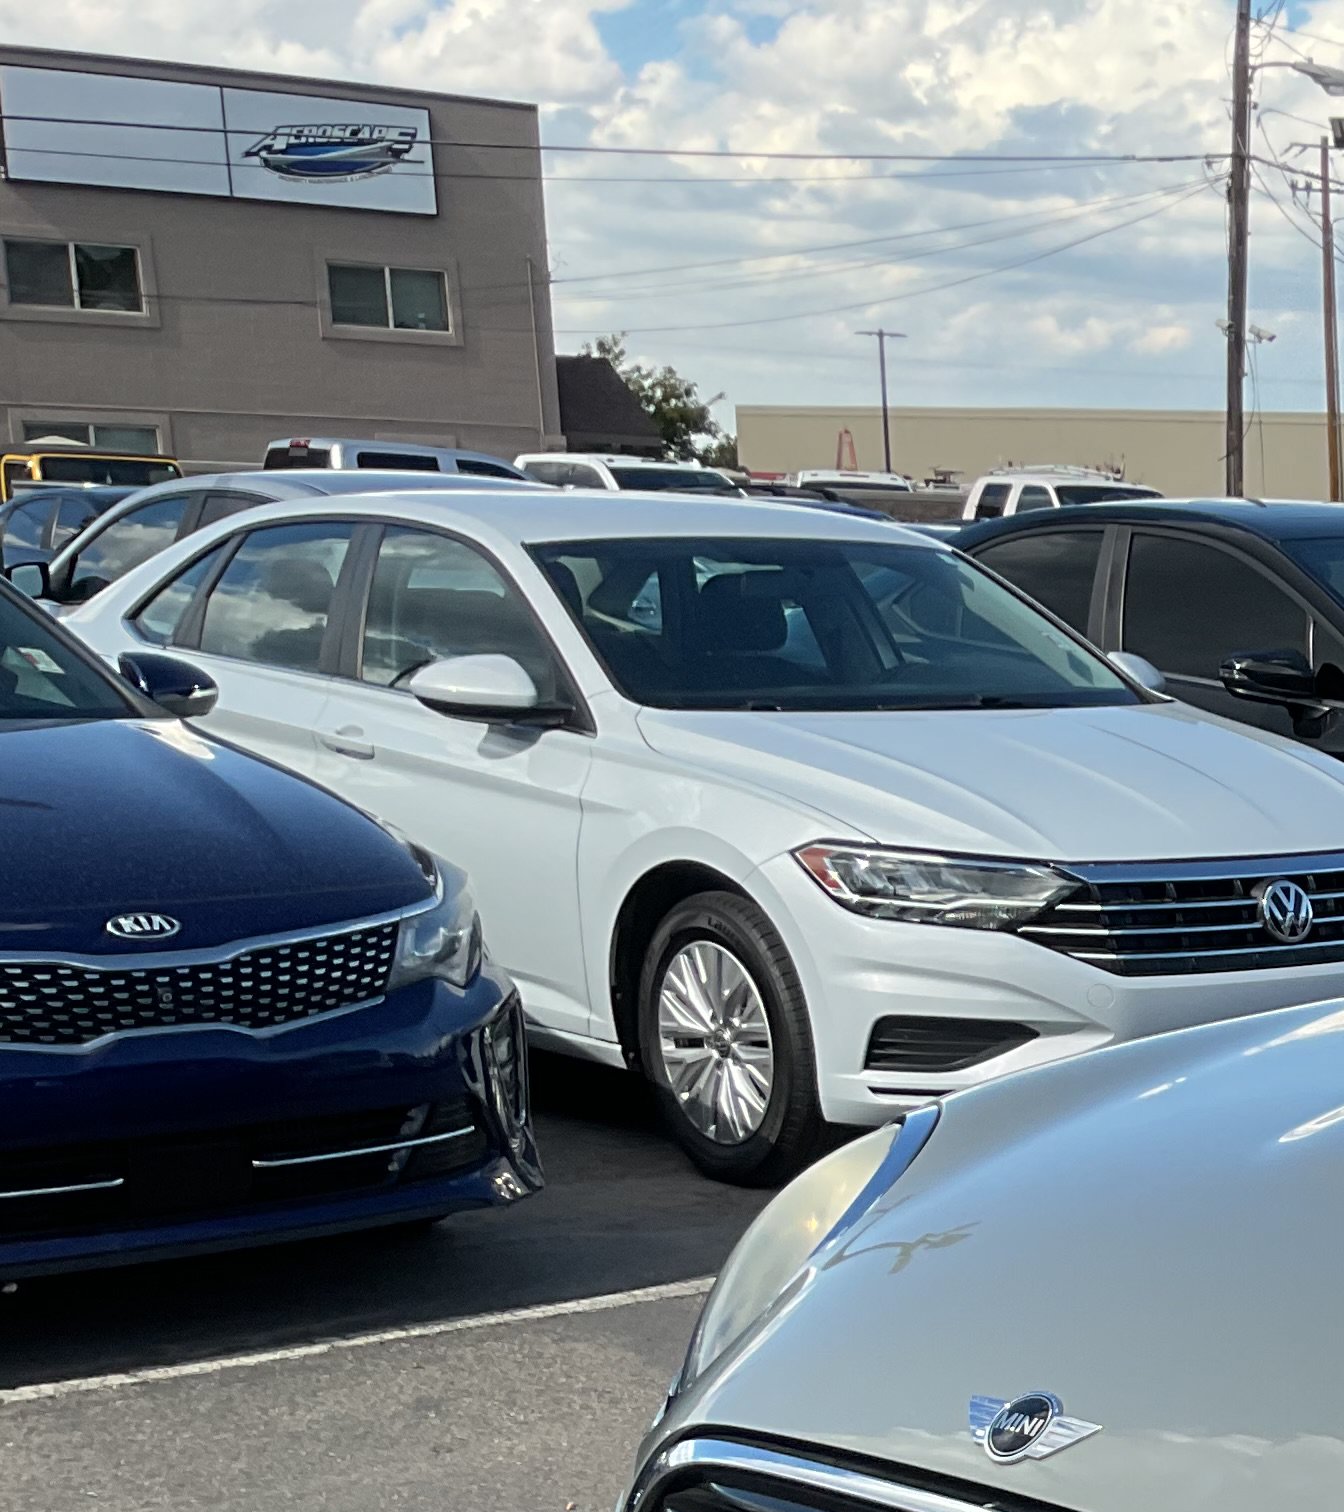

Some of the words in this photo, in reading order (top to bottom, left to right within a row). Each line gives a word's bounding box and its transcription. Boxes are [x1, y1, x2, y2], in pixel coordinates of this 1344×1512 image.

[244, 124, 418, 157] AEROSCAPE
[118, 915, 171, 933] KIA
[1263, 880, 1313, 942] VW
[997, 1411, 1045, 1437] MINI
